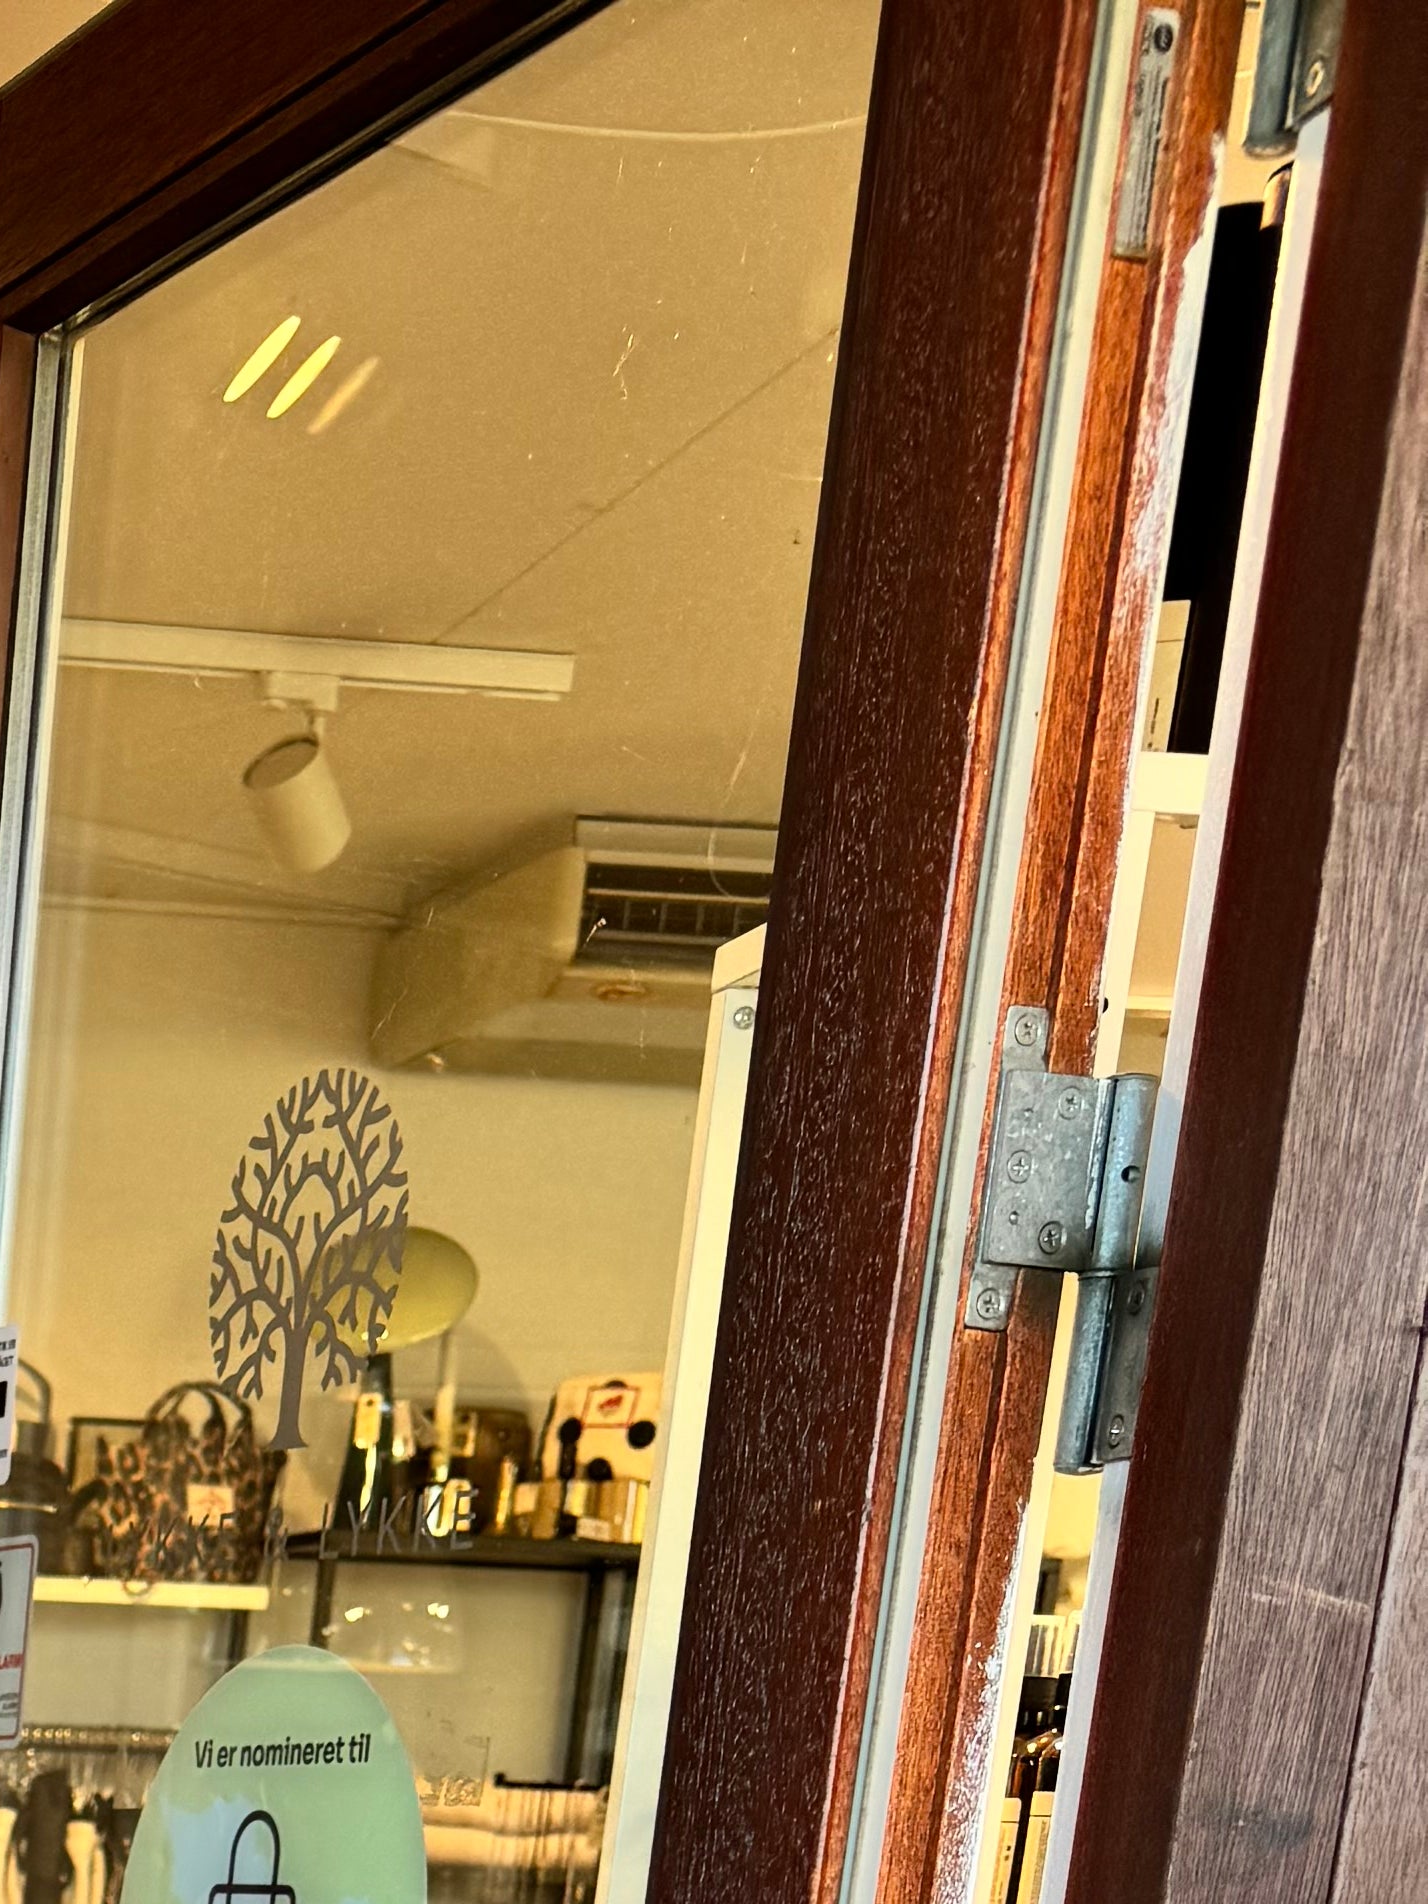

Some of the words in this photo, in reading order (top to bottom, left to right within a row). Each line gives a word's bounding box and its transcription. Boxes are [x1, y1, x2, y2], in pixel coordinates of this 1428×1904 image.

[319, 1488, 478, 1560] LYKKE
[195, 1739, 213, 1769] Vi
[217, 1746, 238, 1767] er
[240, 1736, 344, 1768] nomineret
[348, 1733, 371, 1763] til
